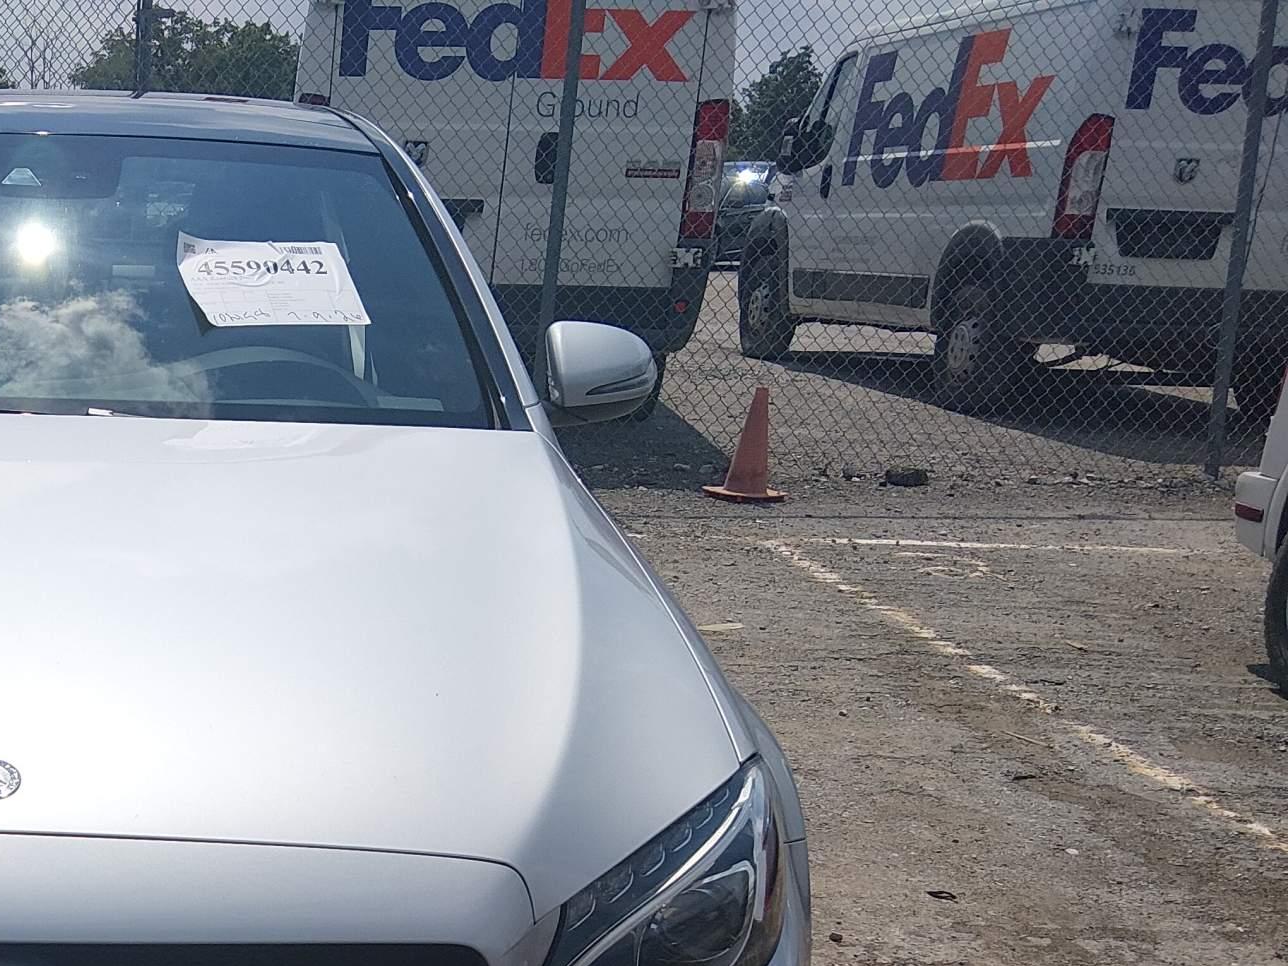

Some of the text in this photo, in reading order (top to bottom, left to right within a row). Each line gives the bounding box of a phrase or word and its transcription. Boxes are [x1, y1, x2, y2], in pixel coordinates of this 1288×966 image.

[536, 91, 640, 119] Gound
[842, 28, 1055, 189] FedEx
[197, 258, 328, 277] 45590442
